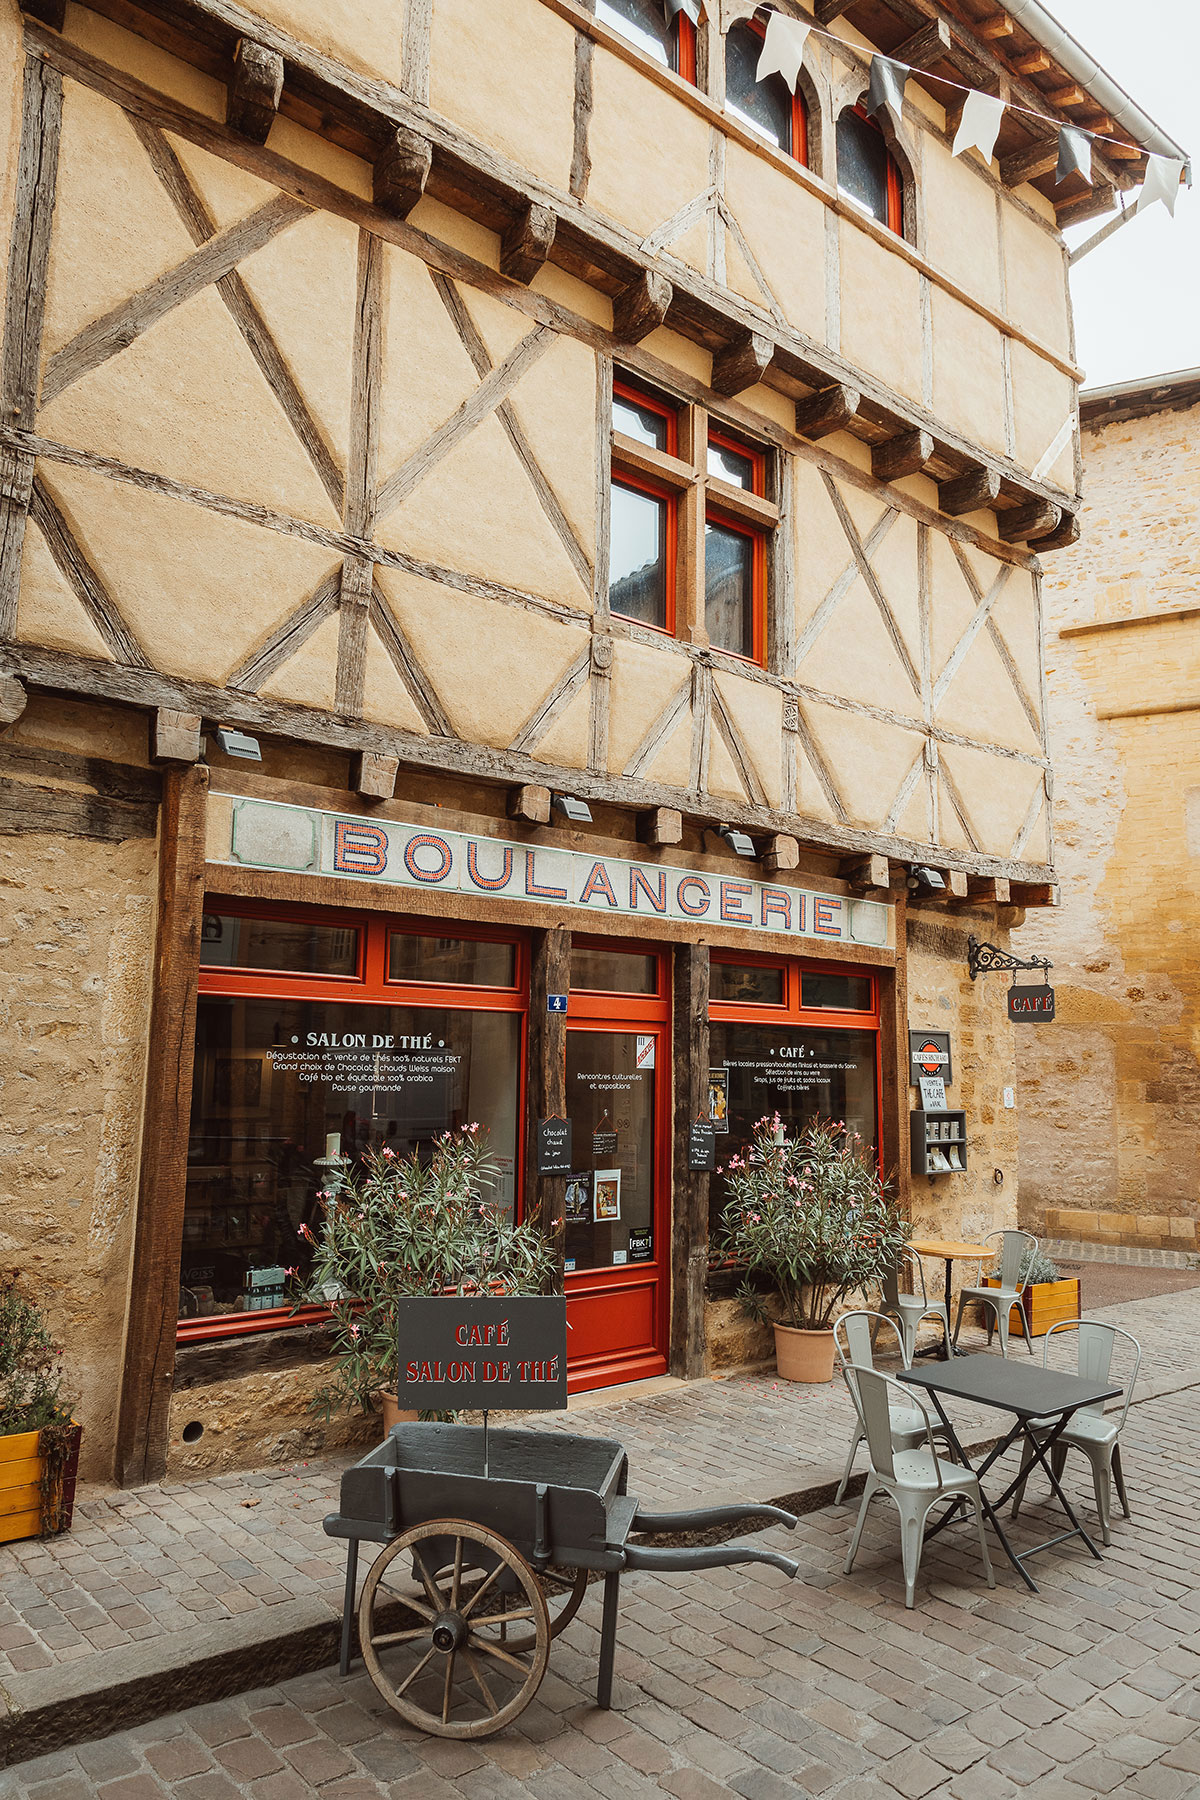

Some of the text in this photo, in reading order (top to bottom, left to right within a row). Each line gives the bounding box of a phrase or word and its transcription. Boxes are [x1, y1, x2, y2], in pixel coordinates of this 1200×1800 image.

[333, 820, 843, 937] BOULANGERIE
[553, 997, 562, 1010] 4
[1010, 992, 1053, 1013] CAFÉ
[306, 1032, 433, 1049] SALON DE THÉ
[266, 1050, 320, 1062] Dégustation
[321, 1052, 332, 1061] et
[334, 1053, 358, 1061] vente
[360, 1053, 370, 1062] de
[371, 1053, 390, 1062] thés
[392, 1054, 410, 1062] 100%
[411, 1055, 443, 1063] naturels
[779, 1045, 805, 1058] CAFÉ
[272, 1061, 456, 1073] Grand choix de Chocolats chauds Weiss maison
[765, 1068, 787, 1076] Sélection
[299, 1072, 434, 1083] Café bio et équitable 100% arabica
[577, 1072, 643, 1081] Rencontres culturelles
[768, 1076, 776, 1084] jus
[783, 1076, 796, 1084] fruits
[331, 1083, 402, 1093] Pause gourmande
[598, 1083, 631, 1091] expositions
[777, 1084, 796, 1092] Coffrets
[455, 1317, 511, 1347] CAFÉ
[405, 1354, 560, 1384] SALON DE THÉ
